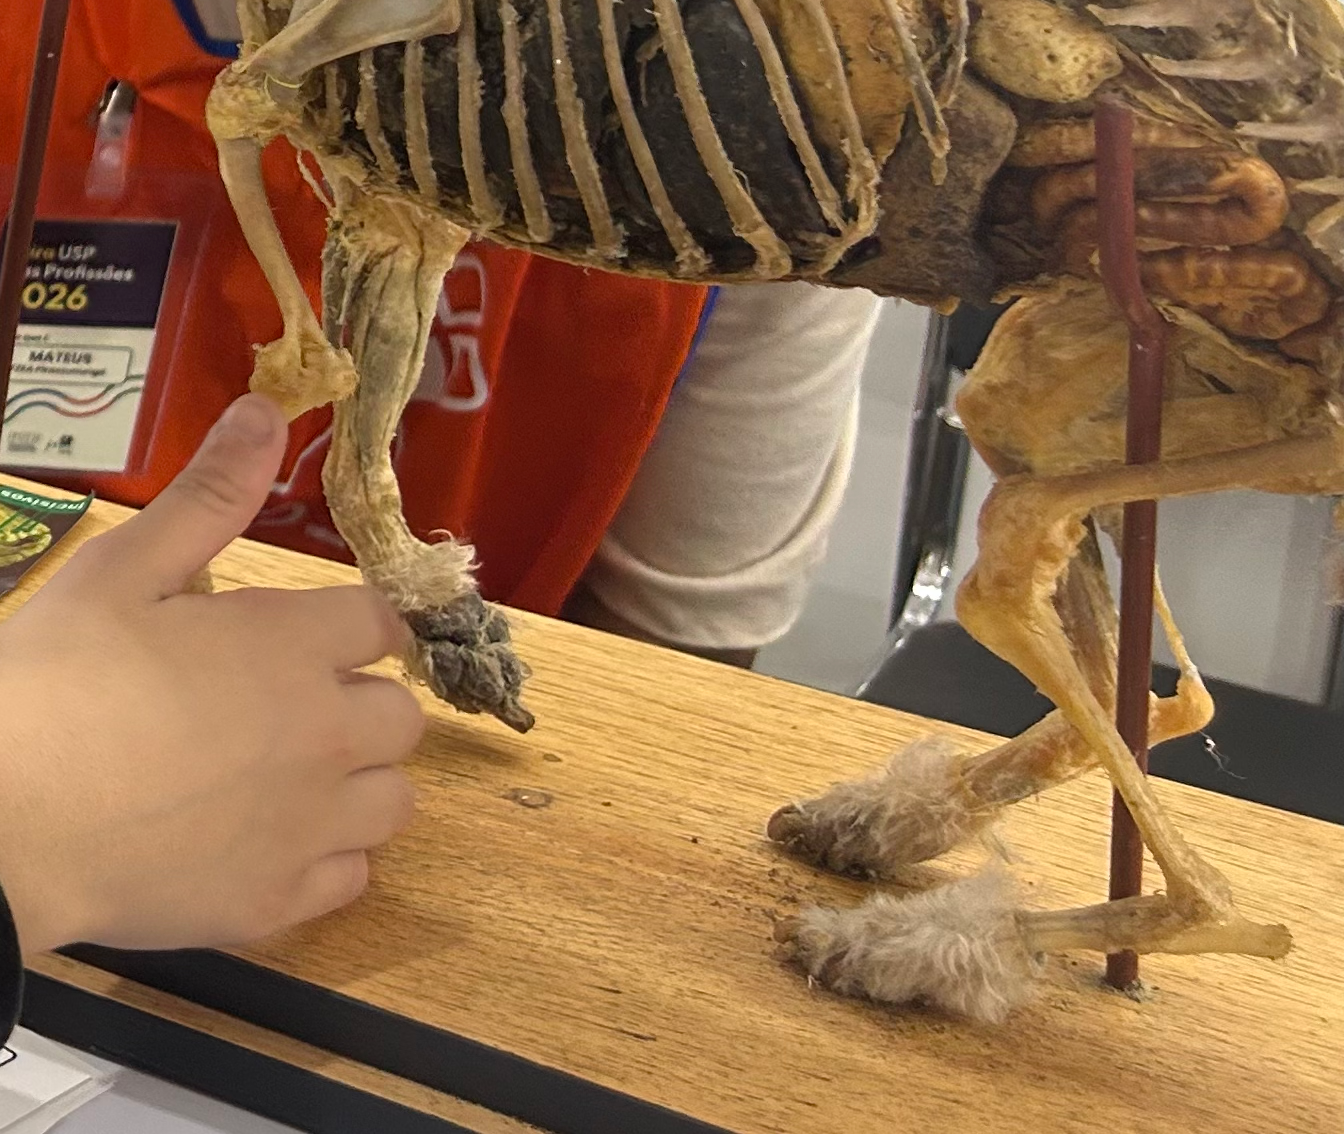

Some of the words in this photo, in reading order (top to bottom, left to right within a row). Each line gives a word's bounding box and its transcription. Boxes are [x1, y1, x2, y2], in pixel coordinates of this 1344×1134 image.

[58, 244, 97, 261] USP
[21, 281, 88, 311] 026
[28, 350, 93, 364] MATEUS
